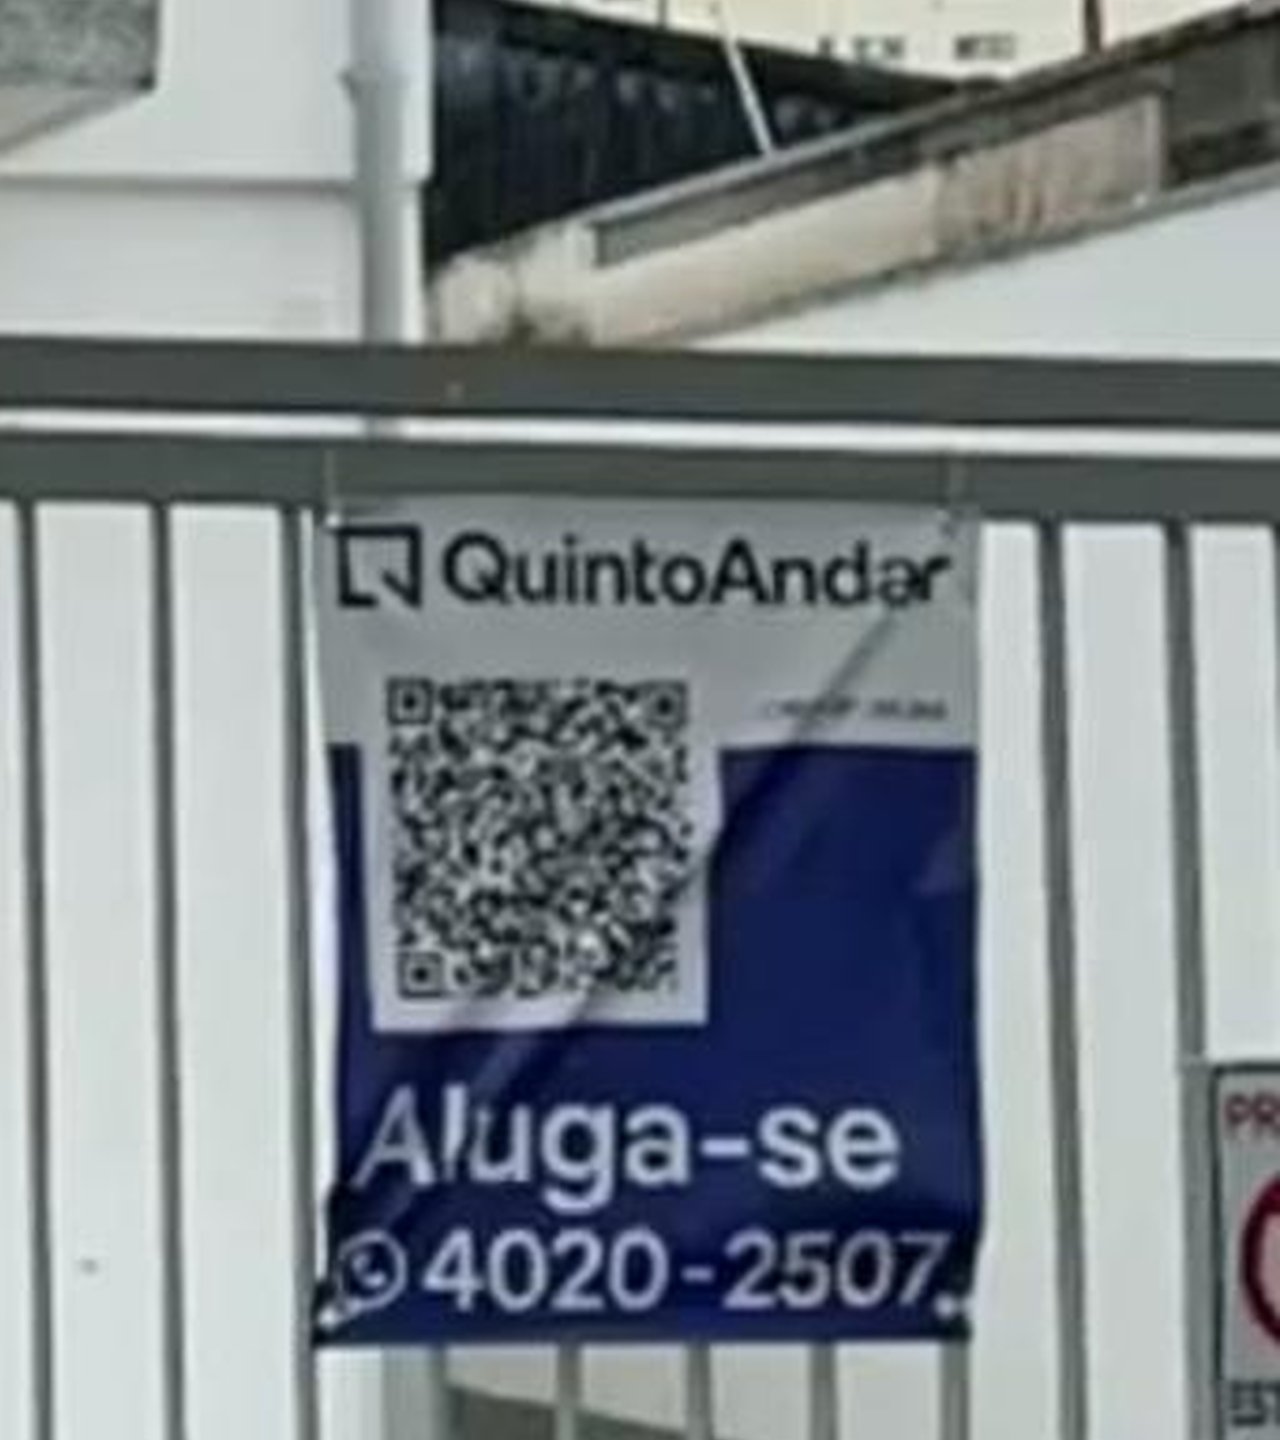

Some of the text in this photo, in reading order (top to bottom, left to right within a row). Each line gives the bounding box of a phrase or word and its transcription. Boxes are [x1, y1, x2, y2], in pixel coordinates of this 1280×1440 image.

[442, 530, 951, 609] QuintoAndar
[350, 1082, 902, 1213] Aluga-se
[421, 1228, 951, 1312] 4020-2507
